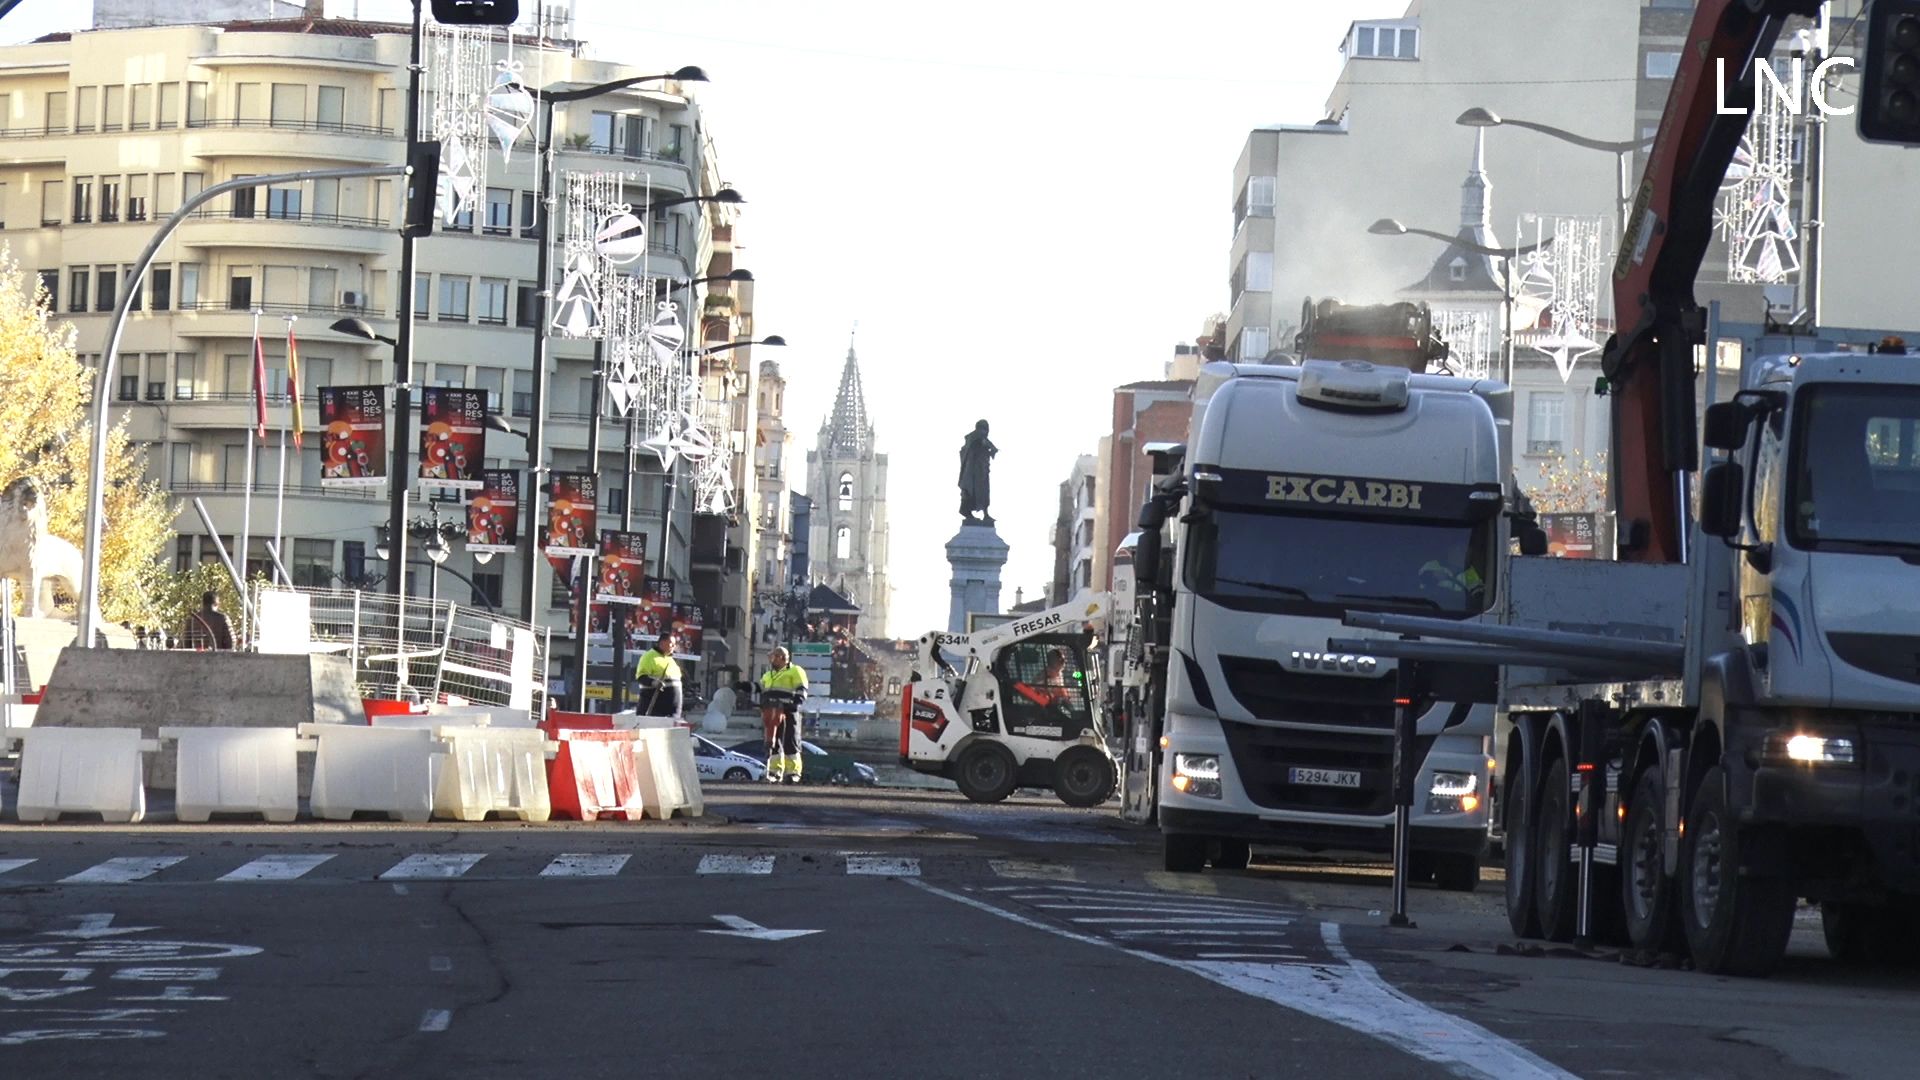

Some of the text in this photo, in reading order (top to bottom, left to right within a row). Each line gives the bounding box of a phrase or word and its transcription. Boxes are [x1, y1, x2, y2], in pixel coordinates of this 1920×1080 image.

[362, 390, 376, 398] SA
[465, 393, 478, 402] SA
[363, 398, 378, 406] BO
[465, 401, 480, 410] BO
[363, 406, 381, 415] RES
[465, 409, 483, 418] RES
[1265, 475, 1423, 510] EXCARBI
[1013, 612, 1062, 637] FRESAR
[1291, 651, 1377, 674] IVECO
[1297, 769, 1358, 786] 5294 JKX
